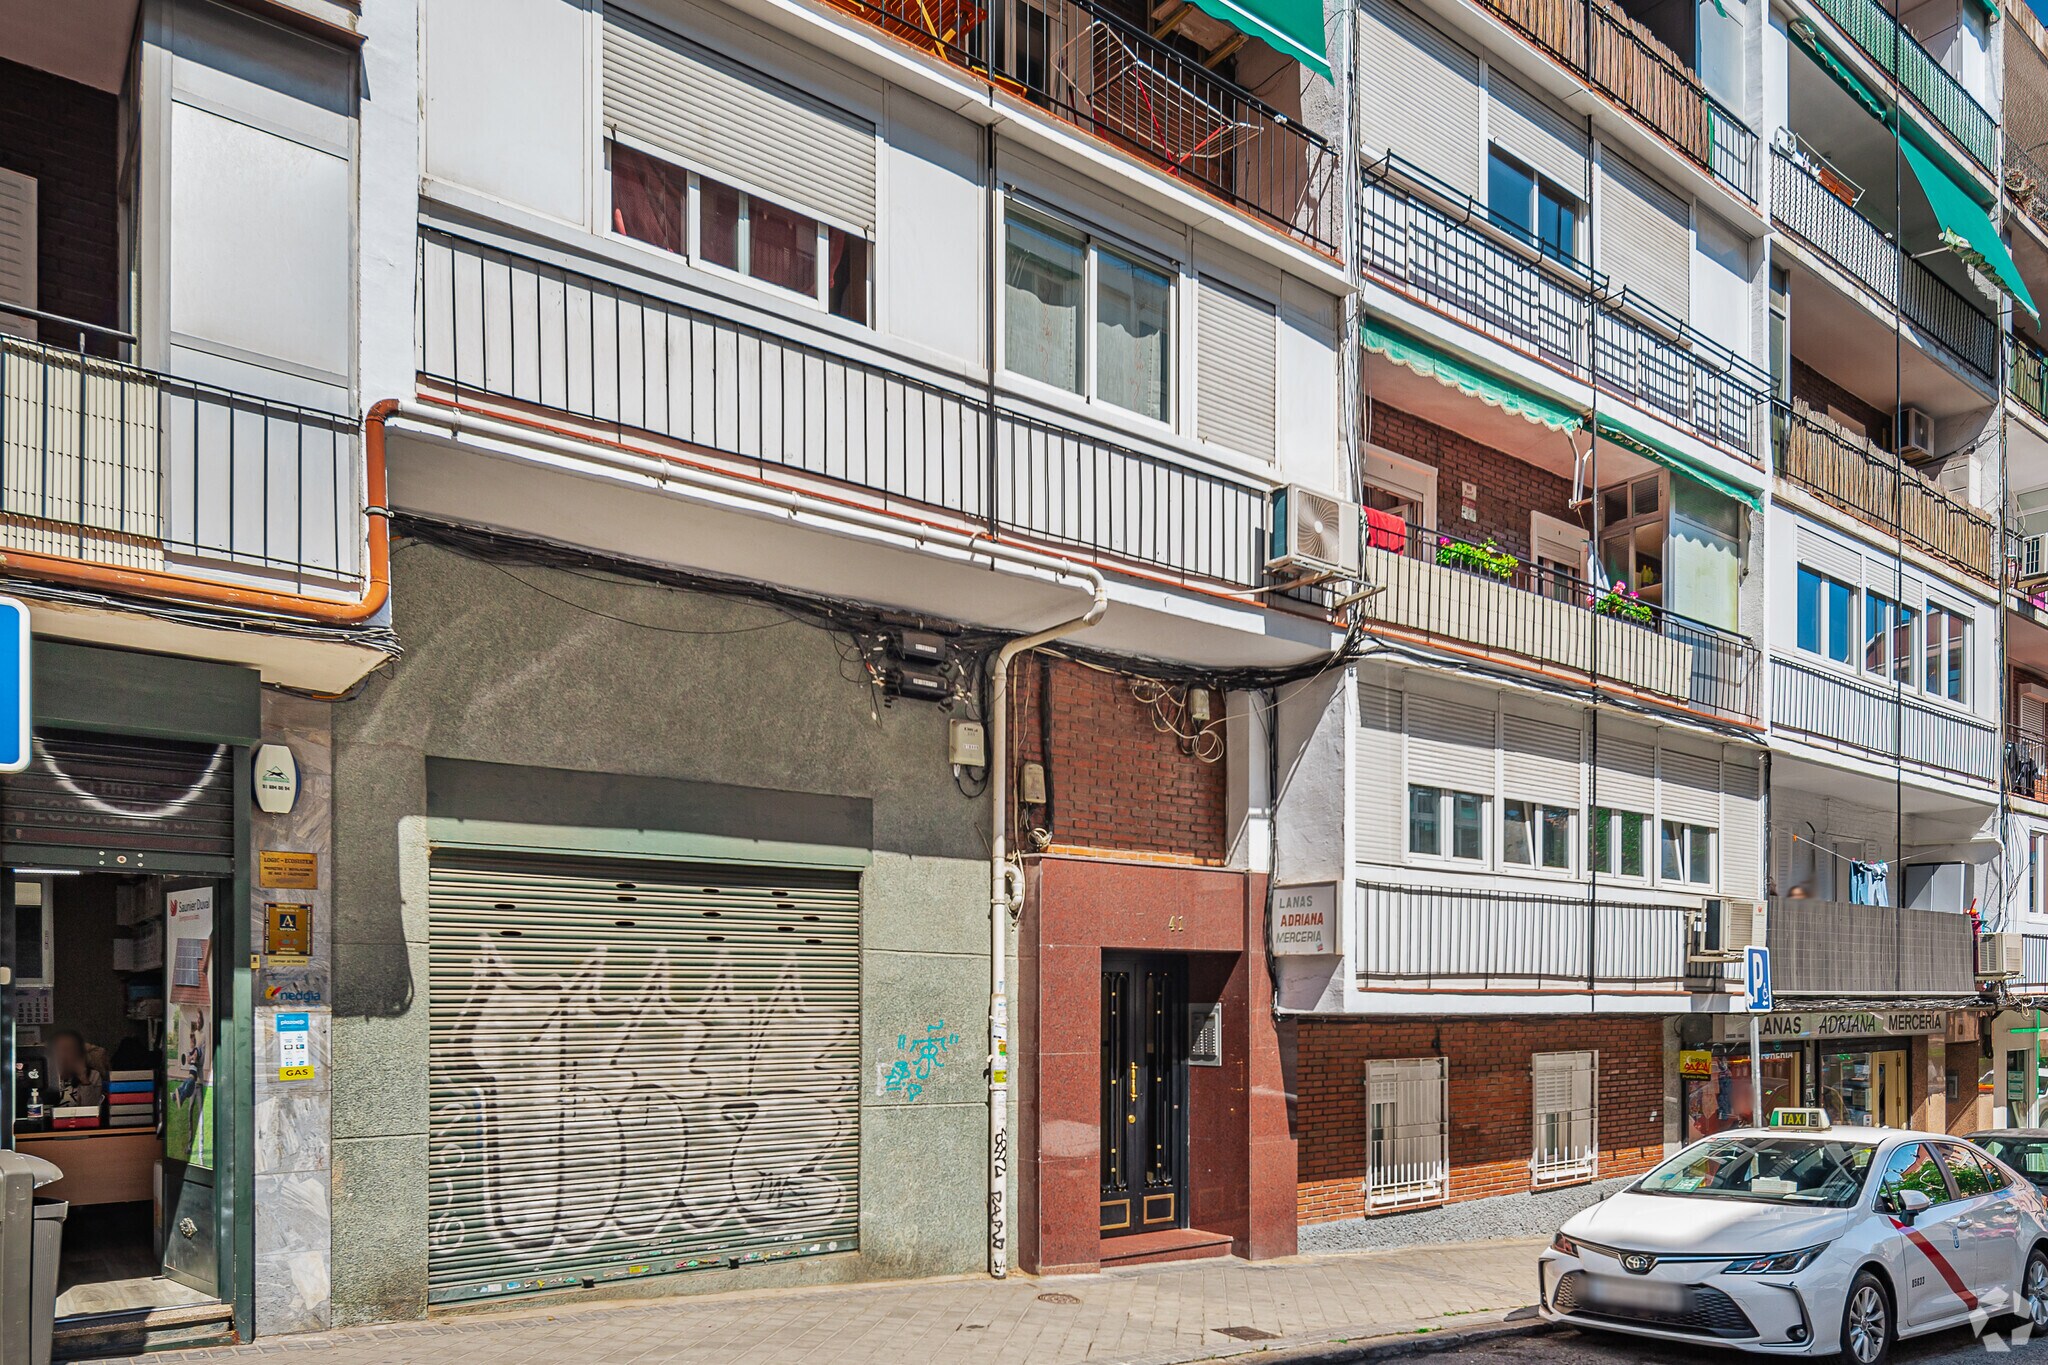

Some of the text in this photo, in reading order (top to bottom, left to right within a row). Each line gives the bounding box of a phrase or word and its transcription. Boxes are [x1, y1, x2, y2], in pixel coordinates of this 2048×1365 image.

[1279, 895, 1313, 909] LANAS
[1168, 915, 1184, 932] 41
[1280, 912, 1324, 927] ADRIANA
[1276, 930, 1322, 944] MERCERIA
[1752, 952, 1763, 1003] P
[280, 991, 321, 1003] nedgia
[1759, 1016, 1802, 1035] ANAS
[1818, 1014, 1876, 1035] ADRIANA
[1888, 1011, 1942, 1031] MERCERÍA
[285, 1068, 309, 1077] GAS
[1782, 1113, 1806, 1125] TAXI
